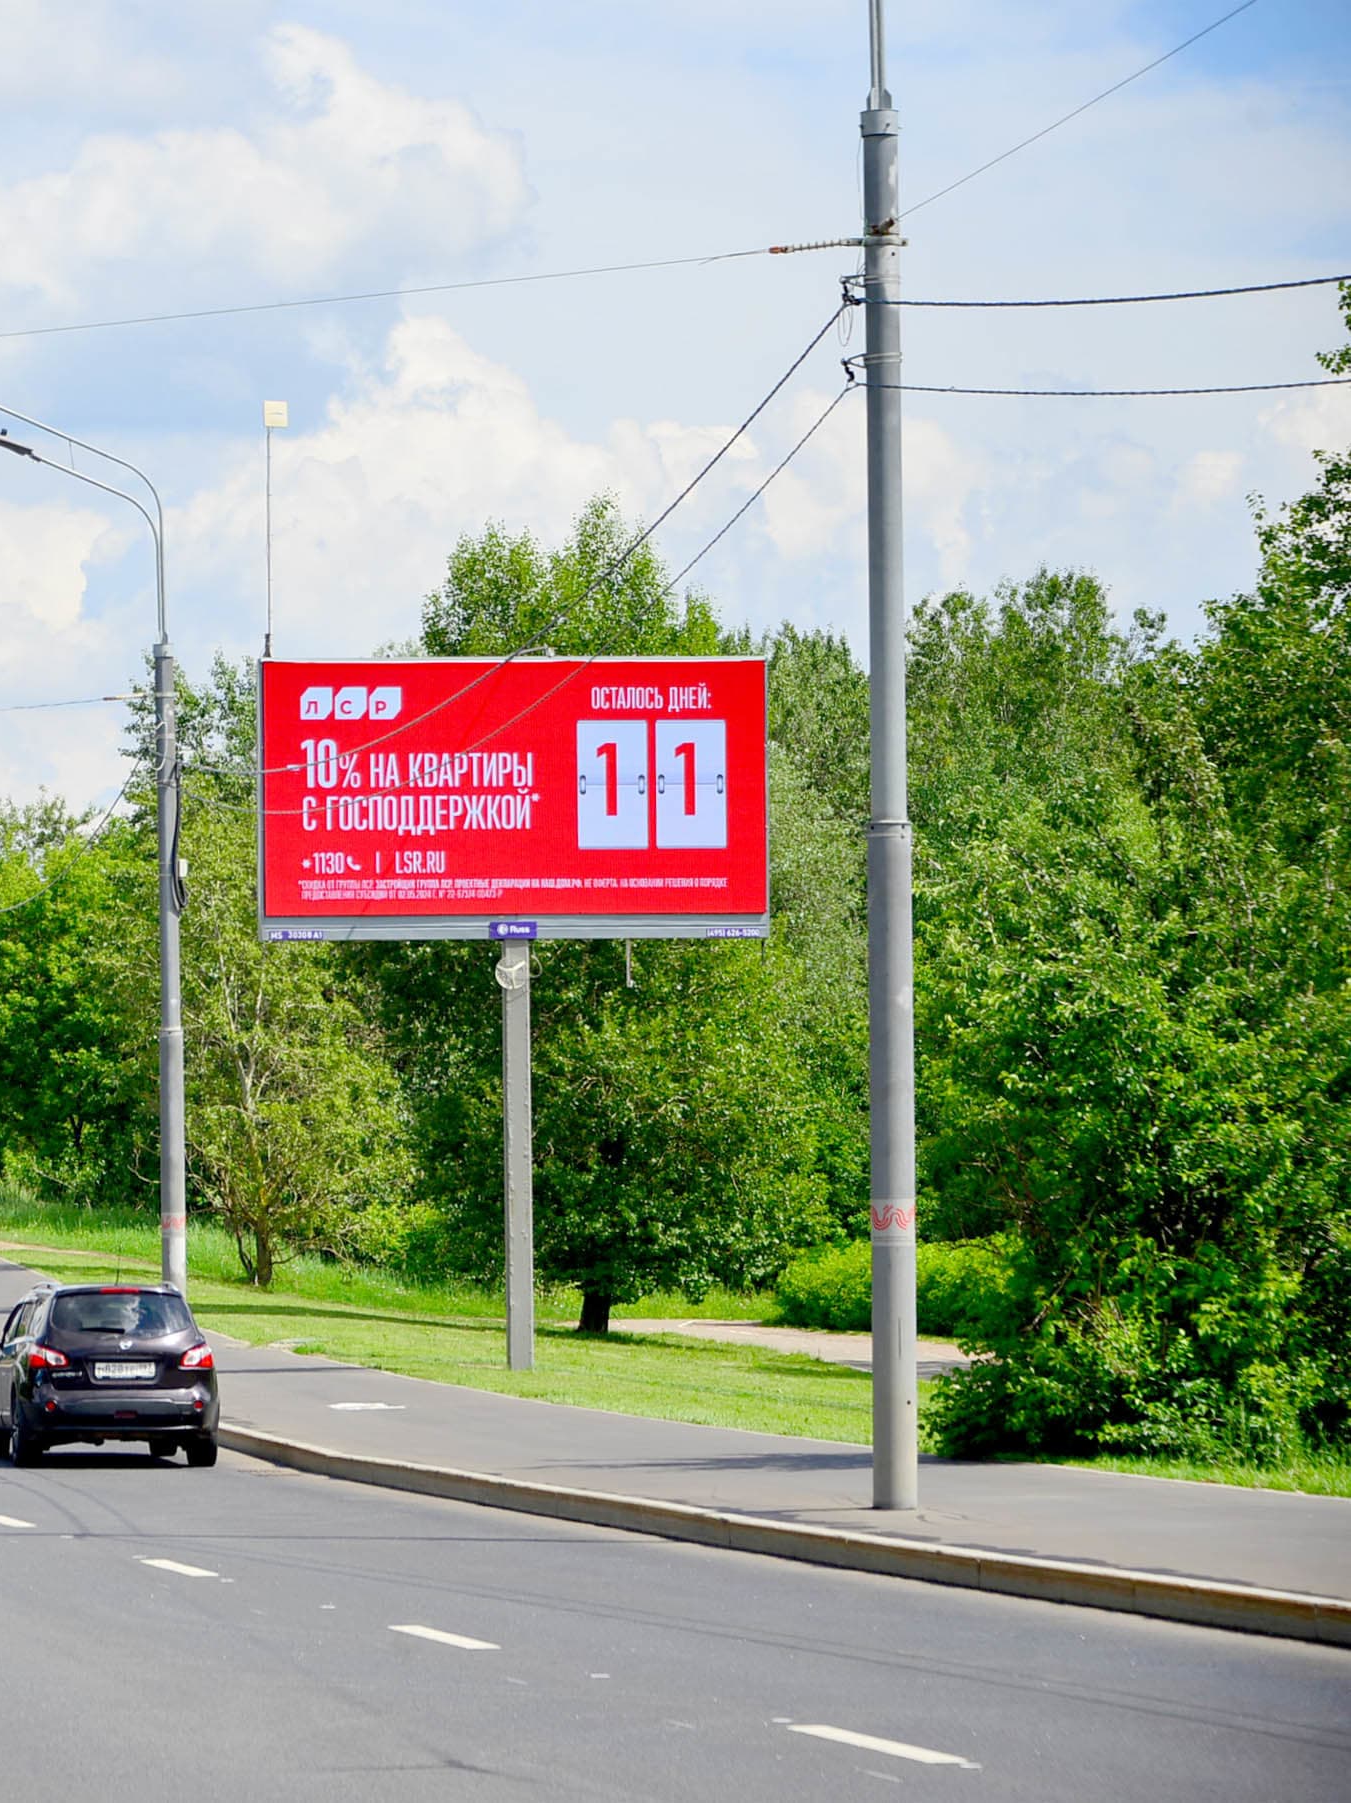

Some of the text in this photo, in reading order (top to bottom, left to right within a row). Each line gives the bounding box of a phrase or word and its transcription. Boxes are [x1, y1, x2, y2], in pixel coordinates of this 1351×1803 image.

[591, 682, 712, 712] ОСТАЛОСЬ ДНЕЙ:
[369, 753, 399, 788] НА
[409, 752, 533, 788] КВАРТИРЫ
[302, 796, 317, 831] С
[395, 851, 445, 874] LSR.RU
